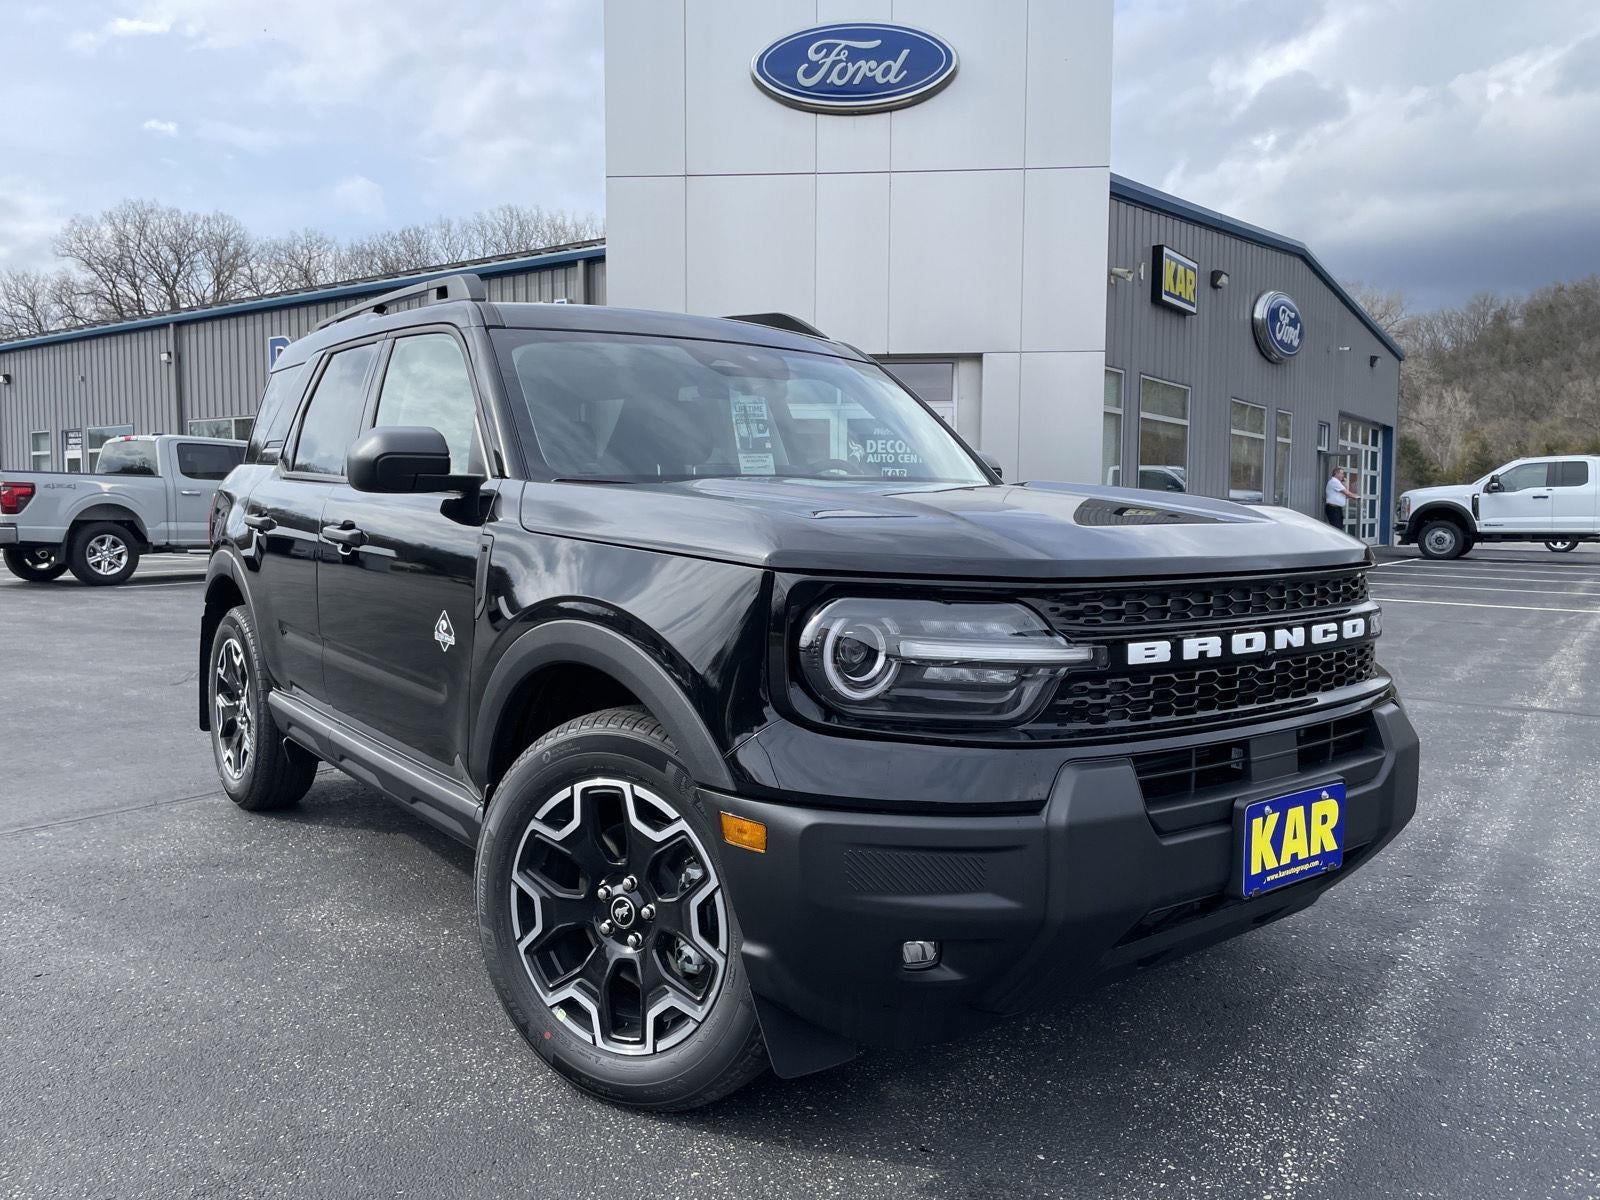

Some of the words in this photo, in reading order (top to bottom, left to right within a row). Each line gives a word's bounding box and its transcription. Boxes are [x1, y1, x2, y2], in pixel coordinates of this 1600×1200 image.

[797, 39, 911, 87] Ford
[1165, 258, 1196, 303] KAR
[1276, 305, 1301, 348] Ford
[866, 453, 895, 463] AUTO
[1127, 618, 1365, 665] BRONCO
[1250, 798, 1339, 876] KAR
[1266, 859, 1320, 883] www.karautogroup.com
